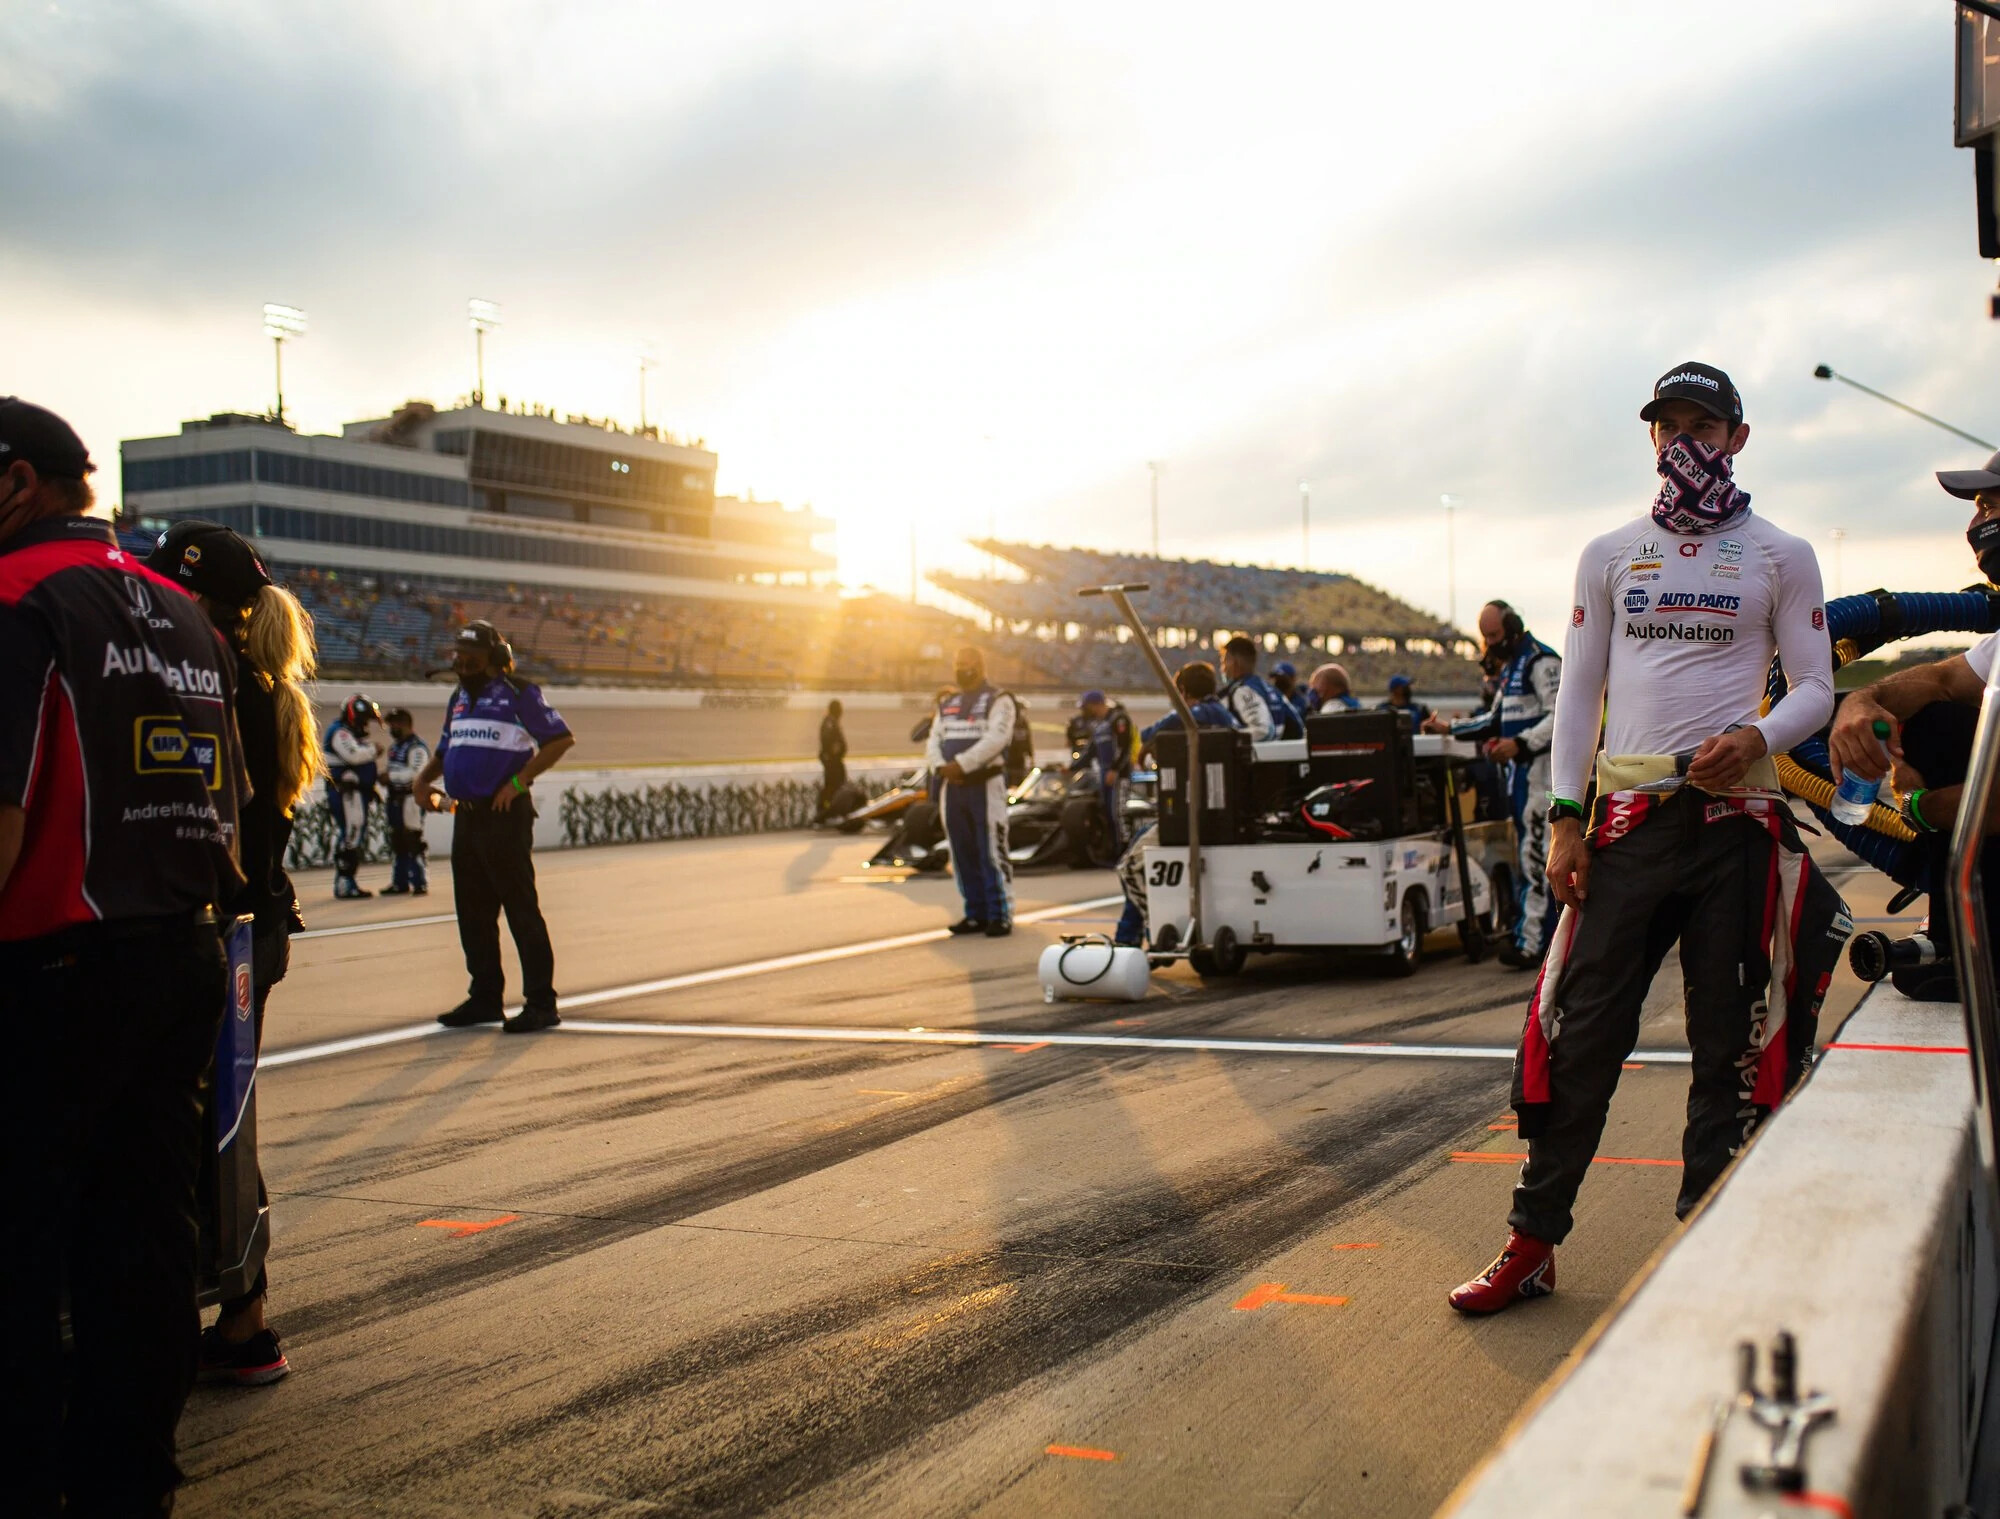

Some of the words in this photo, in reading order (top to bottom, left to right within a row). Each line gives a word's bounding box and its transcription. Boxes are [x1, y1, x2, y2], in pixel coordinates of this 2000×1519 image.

[1658, 372, 1719, 390] AutoNation
[1631, 554, 1665, 562] HONDA
[1711, 571, 1741, 580] EDGE
[1719, 564, 1740, 572] Castrol
[1626, 595, 1645, 607] NAPA
[1658, 592, 1696, 607] AUTO
[1696, 593, 1740, 610] PARTS
[1625, 622, 1734, 641] AutoNation
[1149, 860, 1184, 887] 30
